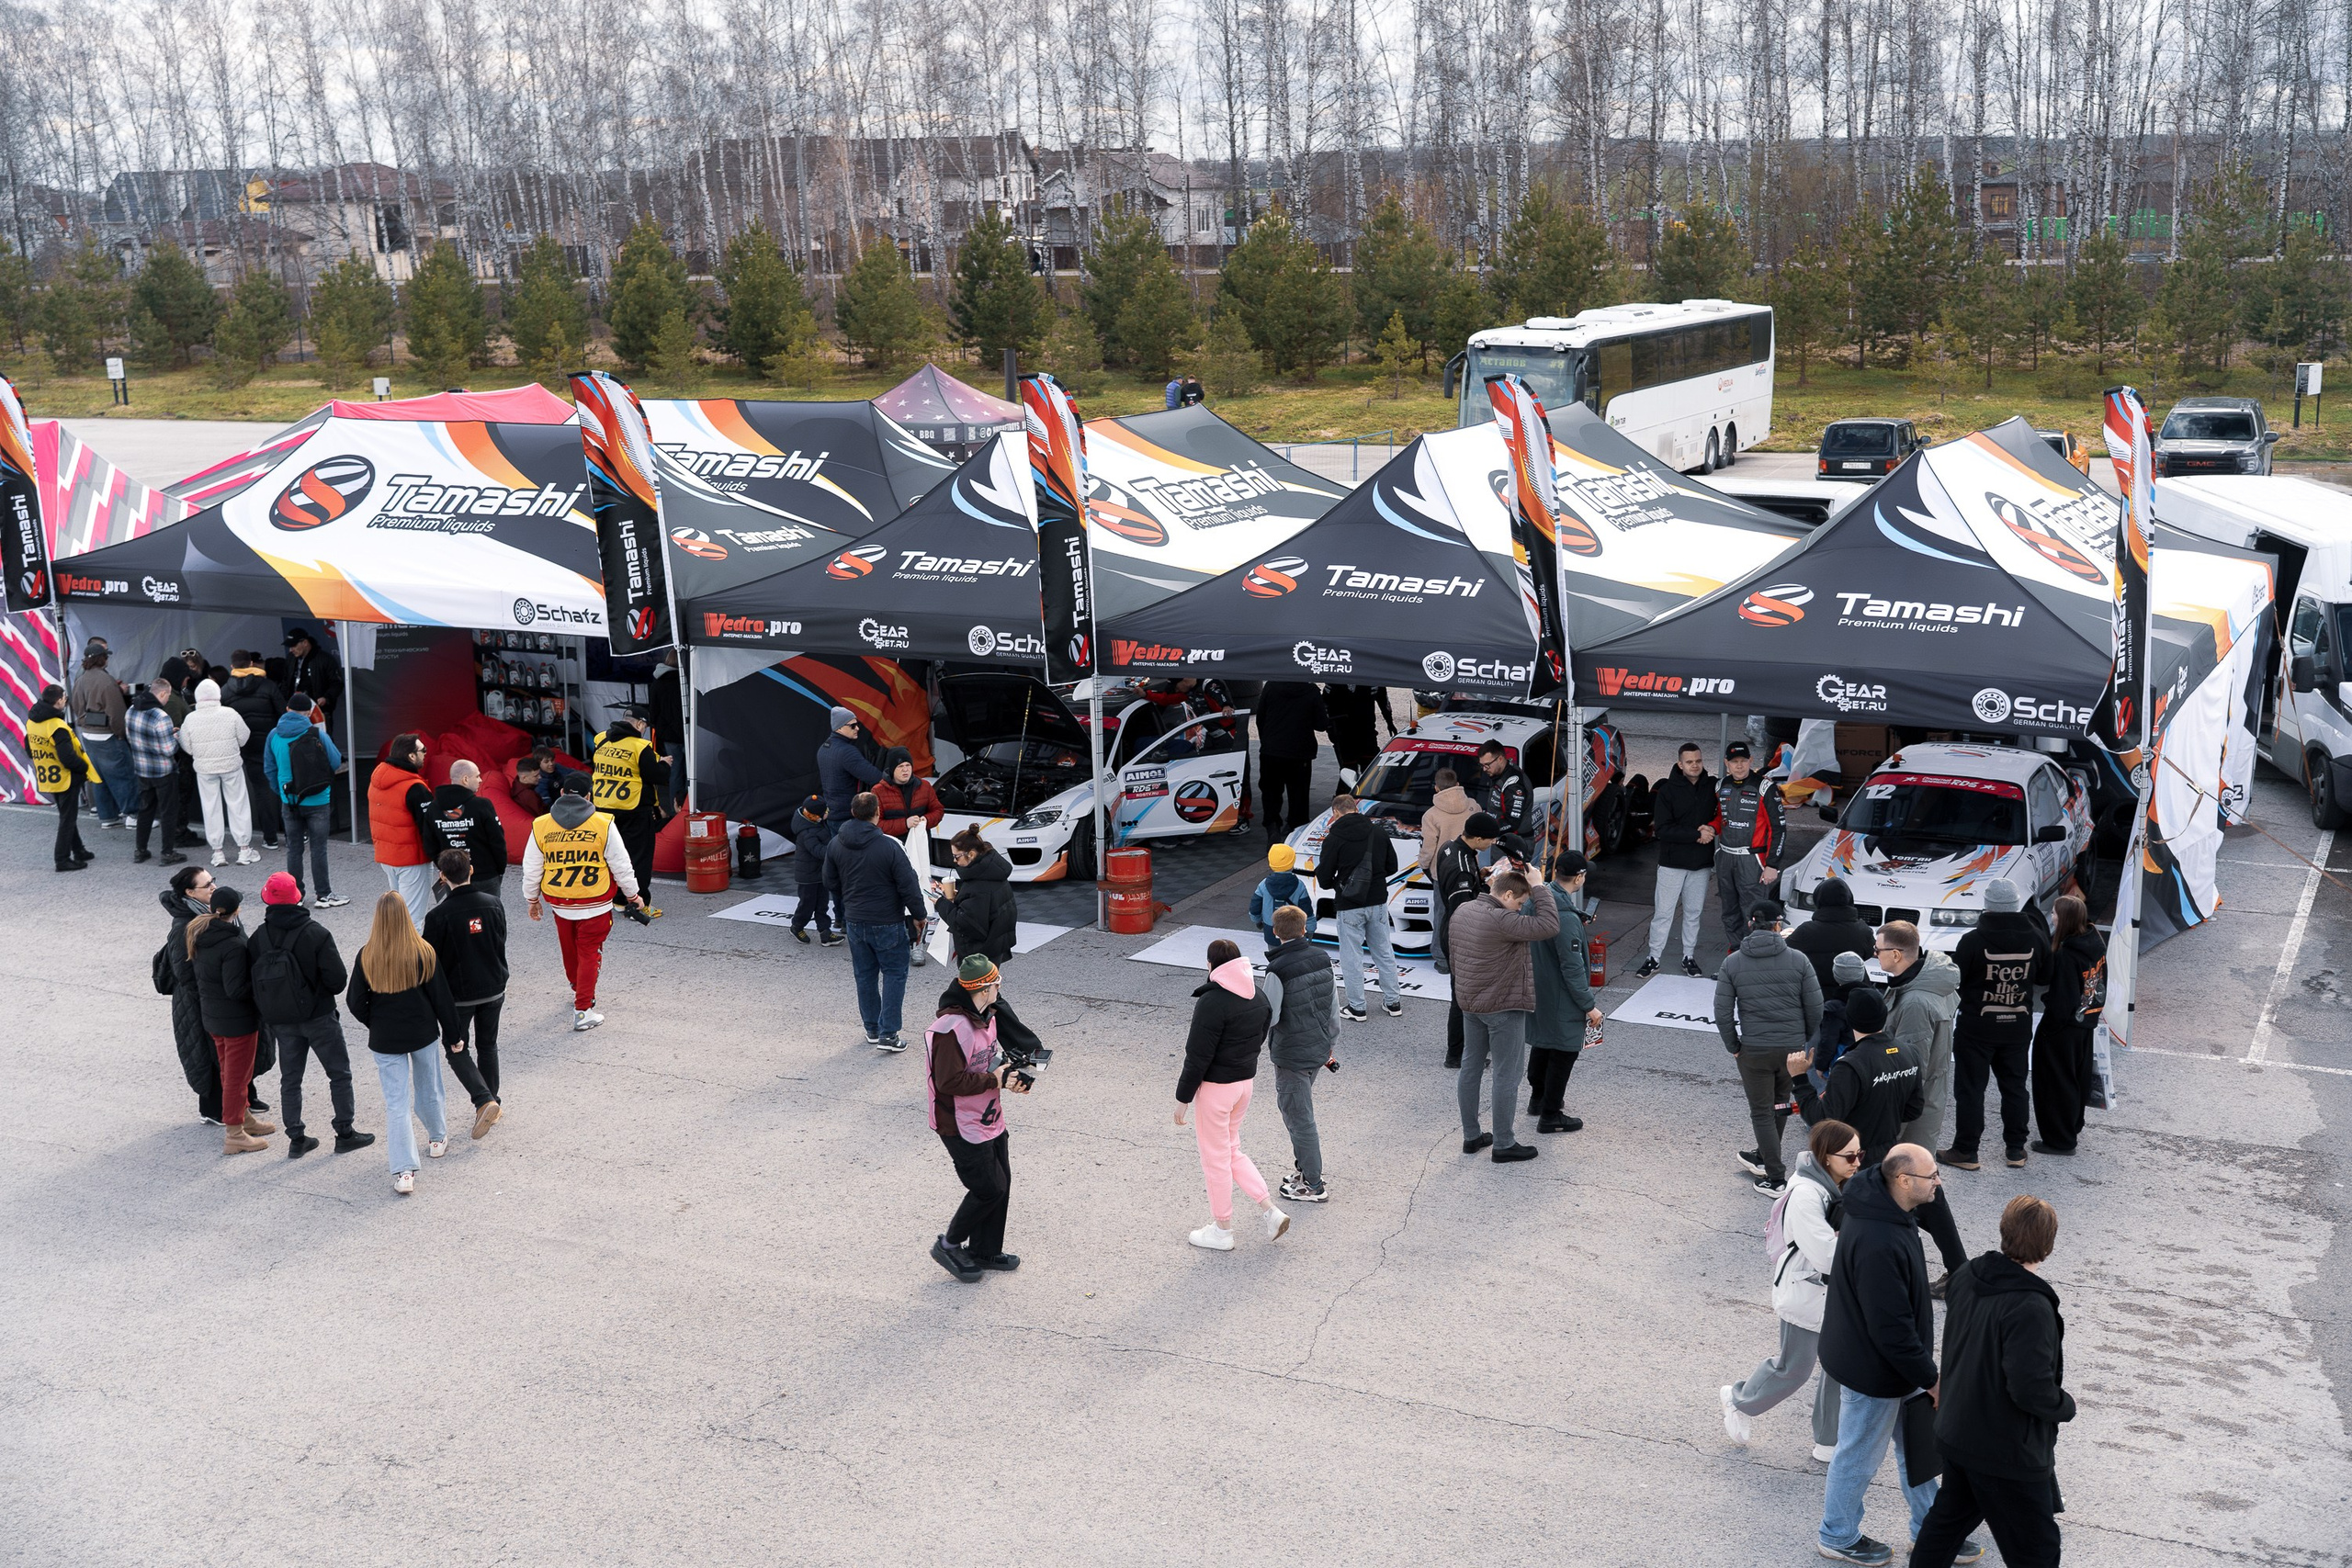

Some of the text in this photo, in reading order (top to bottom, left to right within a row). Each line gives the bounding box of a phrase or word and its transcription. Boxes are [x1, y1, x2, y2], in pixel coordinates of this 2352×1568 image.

[920, 430, 935, 439] BBQ
[383, 474, 586, 518] Tamashi
[1128, 459, 1286, 515] Tamashi
[1557, 460, 1679, 513] Tamashi
[368, 514, 496, 535] Premium liquids
[1181, 505, 1269, 530] Premium liquids
[10, 494, 38, 569] Tamashi
[714, 525, 815, 546] Tamashi
[618, 519, 644, 605] Tamashi
[899, 551, 1035, 577] Tamashi
[56, 573, 129, 595] Vedro.pro
[141, 575, 178, 597] GEAR
[642, 570, 652, 595] Premium
[892, 572, 978, 583] Premium liquids
[1065, 536, 1085, 628] Tamashi
[1327, 565, 1486, 597] Tamashi
[1322, 589, 1424, 604] Premium liquids
[1836, 592, 2025, 627] Tamashi
[704, 612, 802, 637] Vedro.pro
[858, 617, 910, 642] GEAR
[1838, 618, 1959, 634] Premium liquids
[997, 633, 1046, 653] Sch
[2114, 582, 2127, 694] Tamashi
[1111, 639, 1225, 665] Vedro.pro
[1293, 641, 1351, 667] GEAR
[1457, 659, 1535, 682] Schat
[1596, 668, 1735, 695] Vedro.pro
[1815, 674, 1886, 703] GEAR
[1838, 696, 1887, 712] SET.RU
[2013, 696, 2094, 725] Scha
[33, 750, 56, 761] ДИА
[606, 747, 633, 761] RDS
[1377, 751, 1419, 767] 127
[594, 762, 633, 777] МЕДИА
[1126, 769, 1164, 781] AIMOL
[594, 779, 631, 800] 276
[1133, 784, 1151, 793] RDS
[1865, 784, 1896, 799] 12
[1951, 779, 1980, 788] RDS
[435, 818, 474, 829] Tamashi
[561, 830, 597, 842] RDS
[545, 850, 600, 864] МЕДИА
[548, 865, 599, 887] 278
[1985, 962, 2030, 982] Feel
[1982, 990, 2027, 1005] DRIFT
[1996, 982, 2019, 994] the
